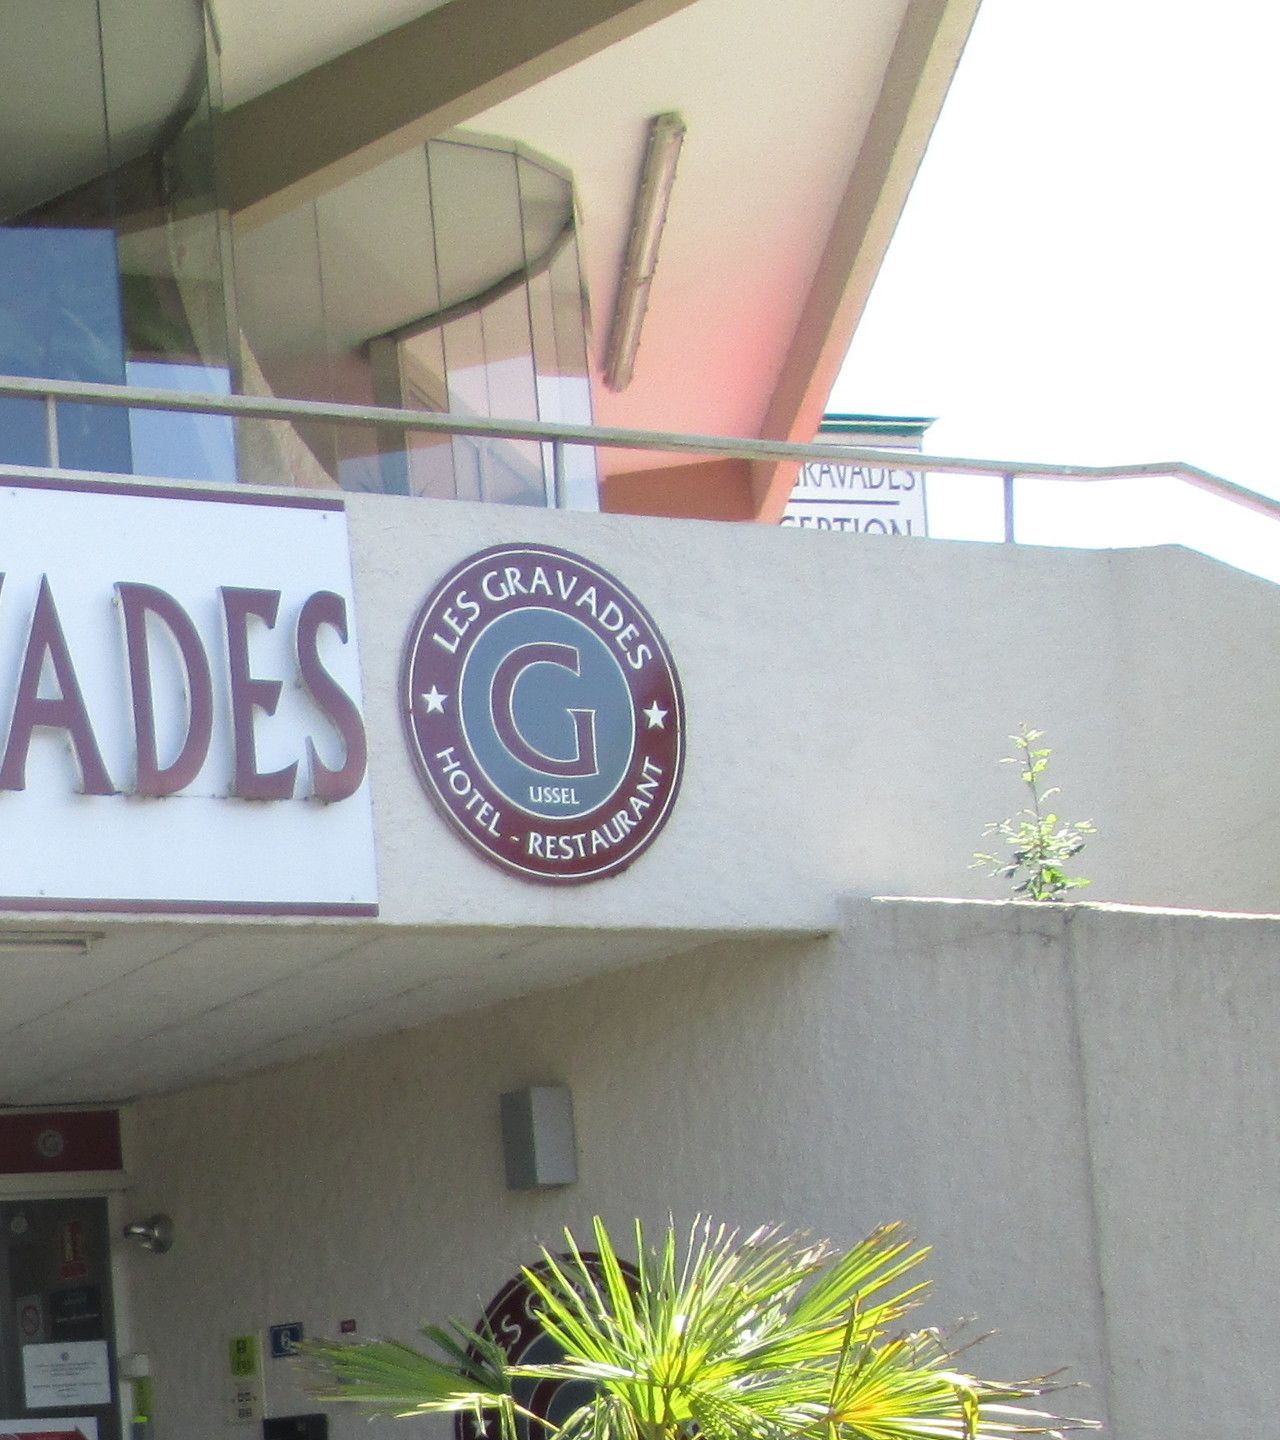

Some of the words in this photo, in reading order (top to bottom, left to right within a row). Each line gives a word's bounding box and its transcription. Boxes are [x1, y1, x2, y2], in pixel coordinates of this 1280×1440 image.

[433, 591, 481, 655] LES
[482, 566, 653, 671] GRAVADES
[490, 641, 600, 778] G
[436, 747, 502, 838] HOTEL
[528, 757, 663, 860] RESTAURANT
[529, 786, 580, 805] USSEL
